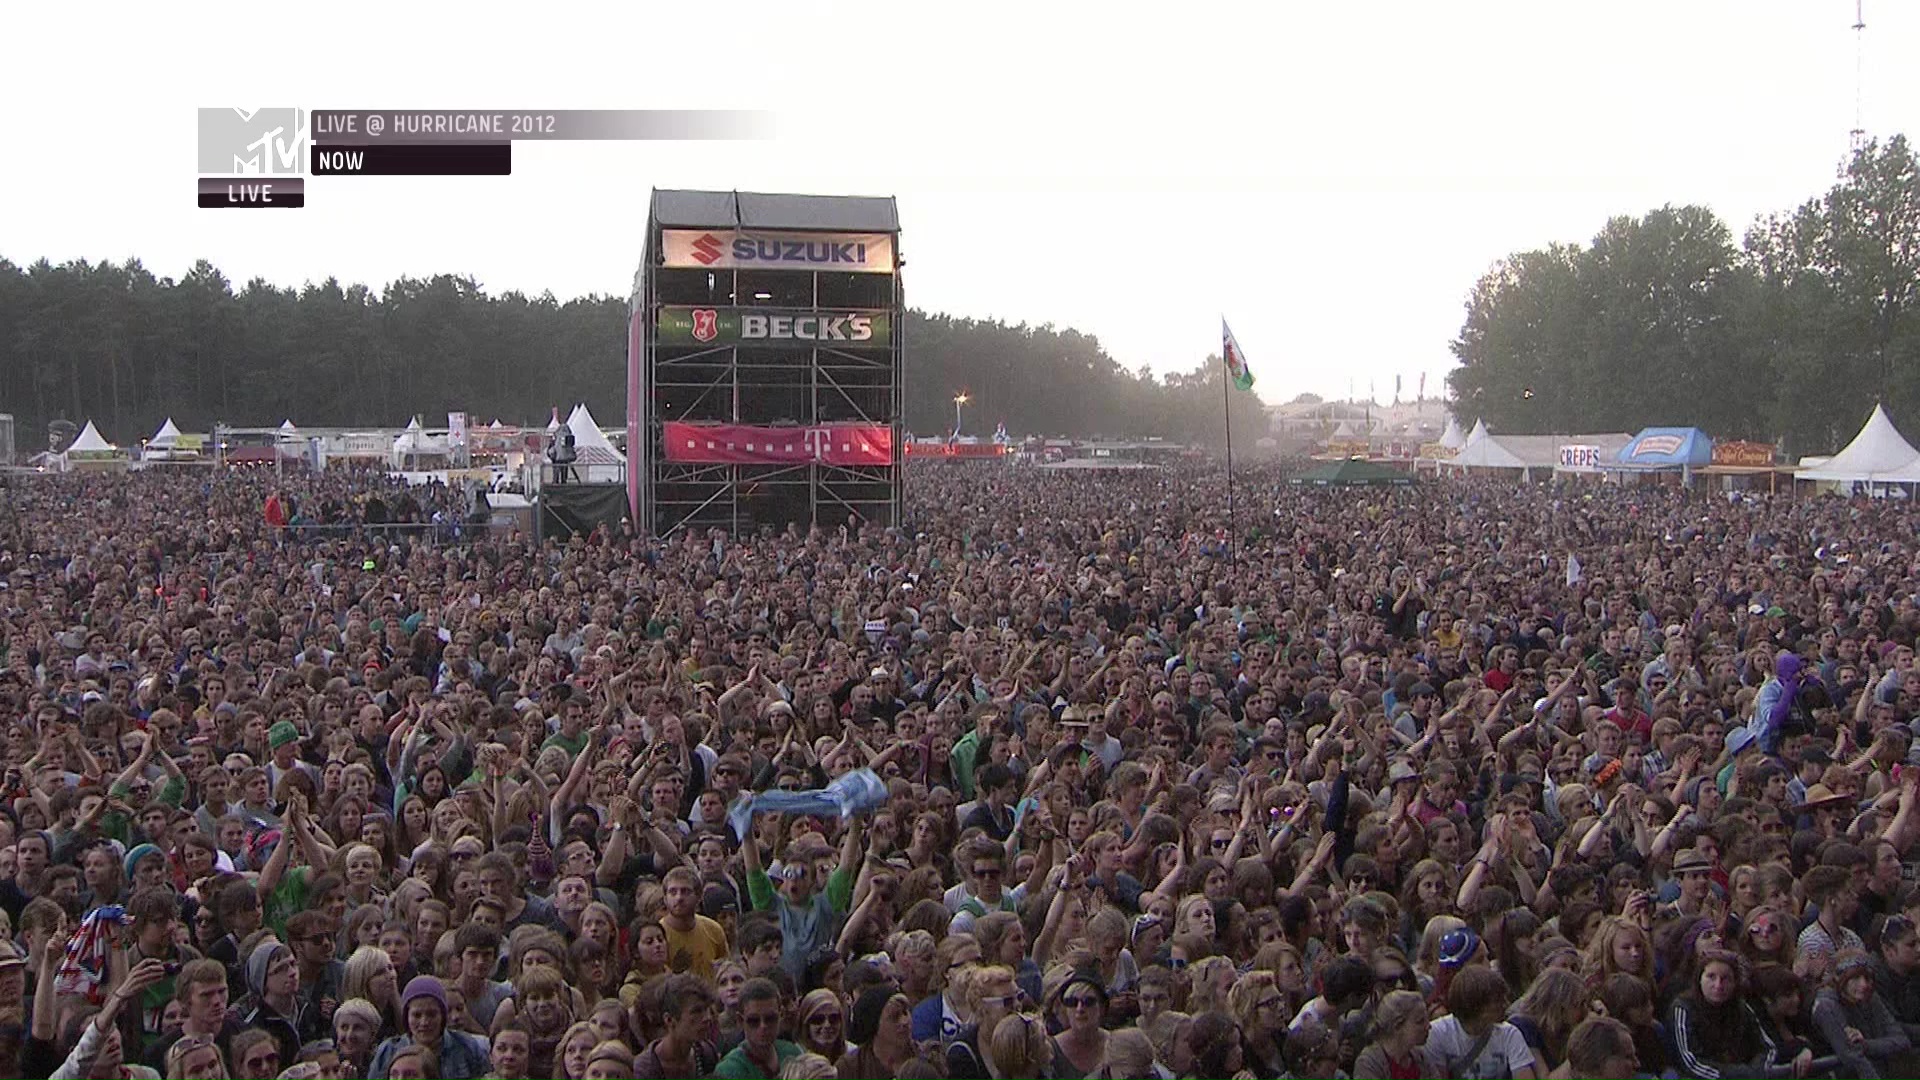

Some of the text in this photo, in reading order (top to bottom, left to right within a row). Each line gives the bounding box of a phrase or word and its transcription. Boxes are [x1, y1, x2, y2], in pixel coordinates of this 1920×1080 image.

[732, 239, 866, 263] SUZUKI
[741, 313, 872, 340] BECK'S
[1560, 447, 1599, 466] CRÊPES
